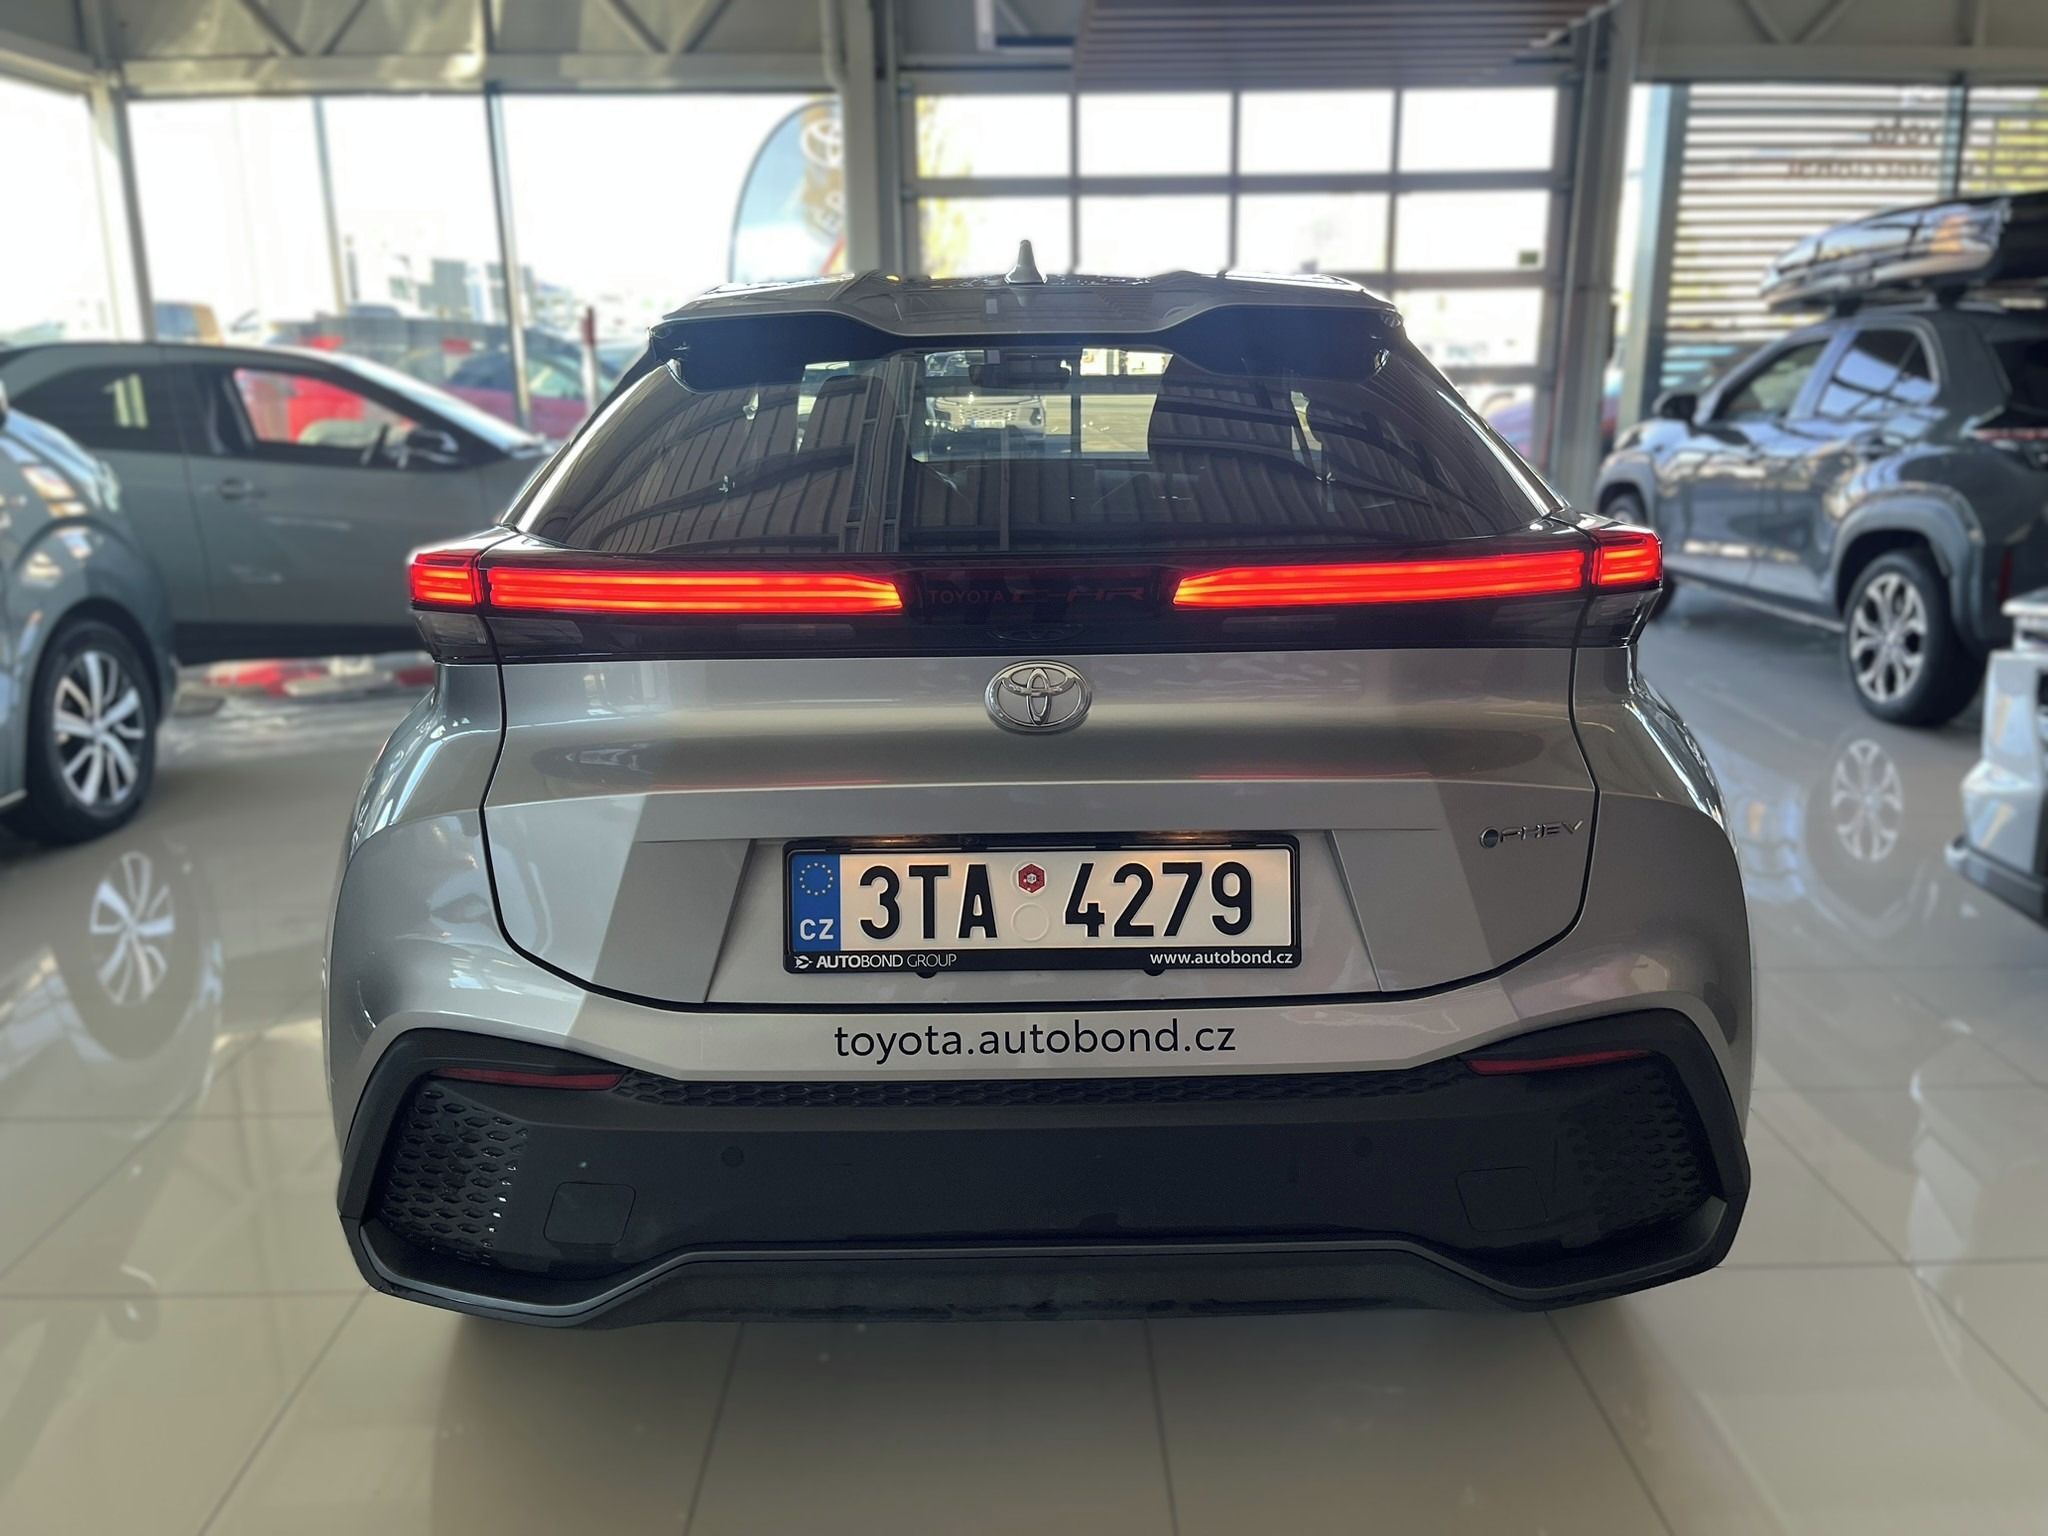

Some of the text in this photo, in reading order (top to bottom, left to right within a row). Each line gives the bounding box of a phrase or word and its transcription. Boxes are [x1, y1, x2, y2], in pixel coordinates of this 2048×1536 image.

[928, 590, 1005, 604] TOYOTA
[1499, 820, 1584, 843] PHEV
[859, 861, 1253, 940] 3TA 4279
[799, 918, 835, 941] CZ
[816, 953, 957, 969] AUTOBOND GROUP
[1150, 950, 1294, 966] www.autobond.cz
[834, 1019, 1237, 1065] toyota.autobond.cz
